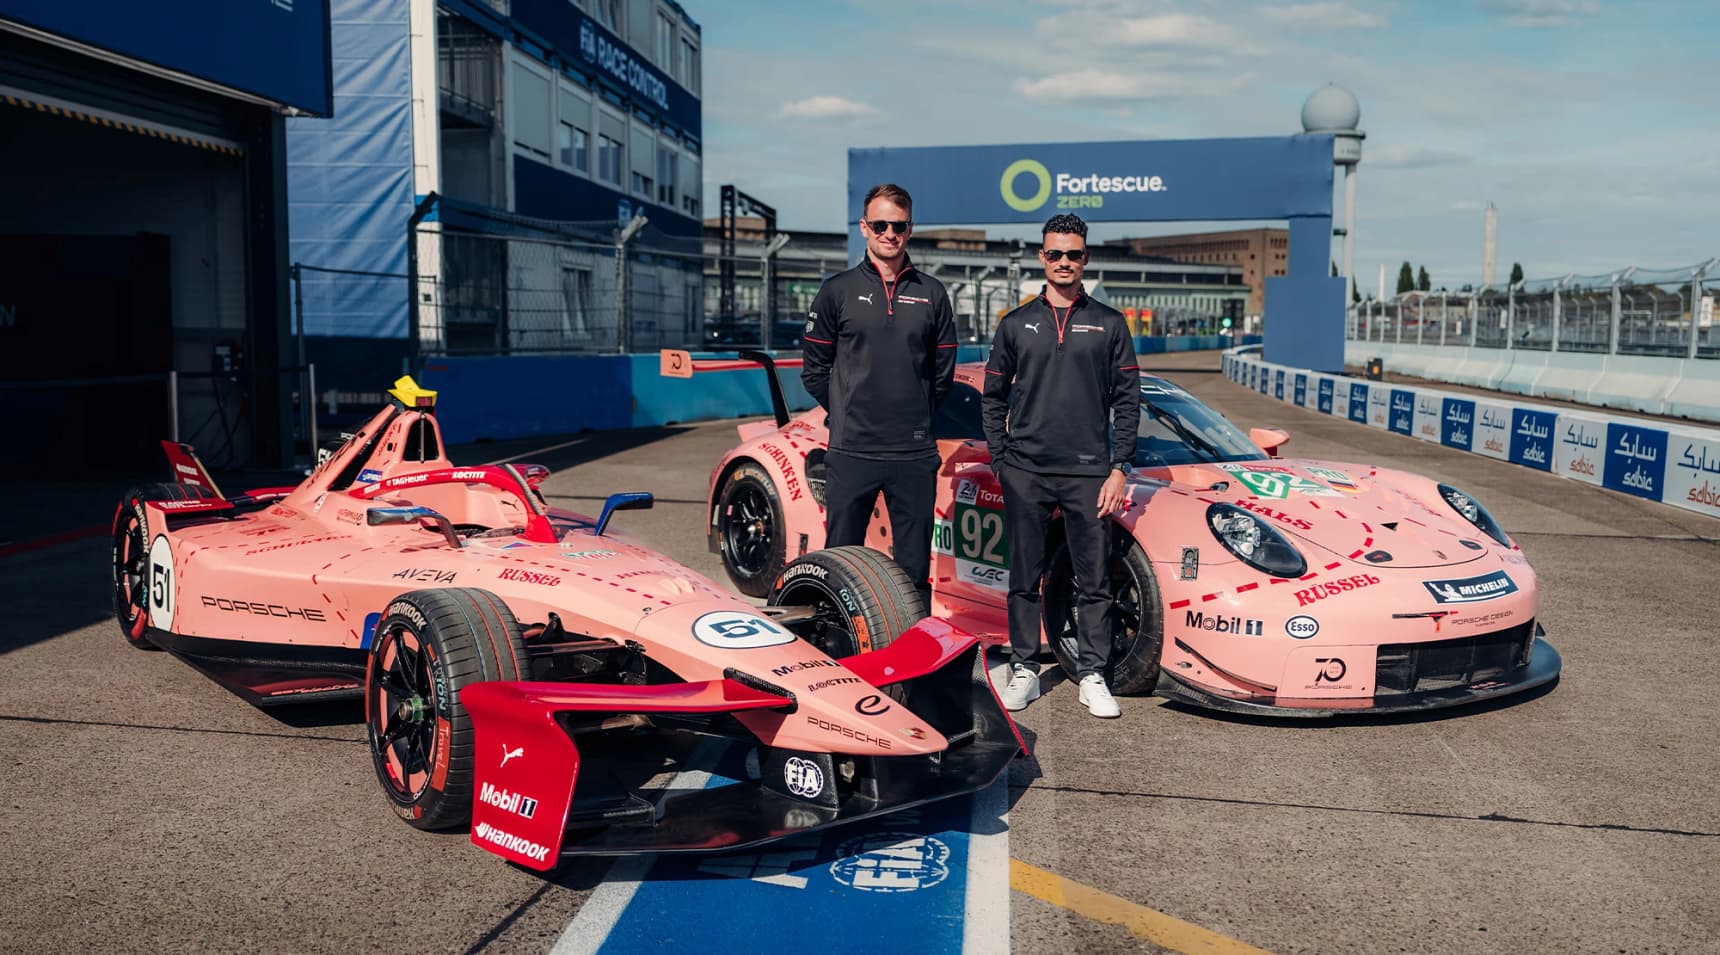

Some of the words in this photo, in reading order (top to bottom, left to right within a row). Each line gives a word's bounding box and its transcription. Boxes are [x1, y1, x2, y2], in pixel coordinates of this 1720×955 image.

[598, 36, 627, 82] RACE
[628, 58, 669, 110] CONTROL
[1516, 414, 1549, 441] سابك
[1563, 423, 1598, 451] سابك
[1522, 441, 1545, 464] sabic
[1614, 432, 1657, 464] سابك
[452, 471, 486, 479] LOCTITE
[1569, 452, 1595, 475] sabic
[1622, 464, 1653, 491] sabic
[980, 489, 1005, 504] TOTA
[1234, 499, 1313, 530] HALS
[934, 524, 953, 551] RO
[961, 508, 1004, 564] 92
[153, 563, 170, 613] 51
[392, 569, 456, 584] AVEVA
[1459, 578, 1509, 595] MICHELIN
[201, 596, 327, 623] PORSCHE
[1186, 610, 1241, 635] Mobil
[709, 618, 781, 639] 51
[1291, 621, 1315, 632] Esso
[772, 660, 825, 677] Mobil
[1315, 657, 1346, 682] 70
[808, 678, 862, 692] LOCTITE
[807, 716, 892, 750] PORSCHE
[787, 763, 818, 790] FIA
[480, 781, 520, 814] Mobil
